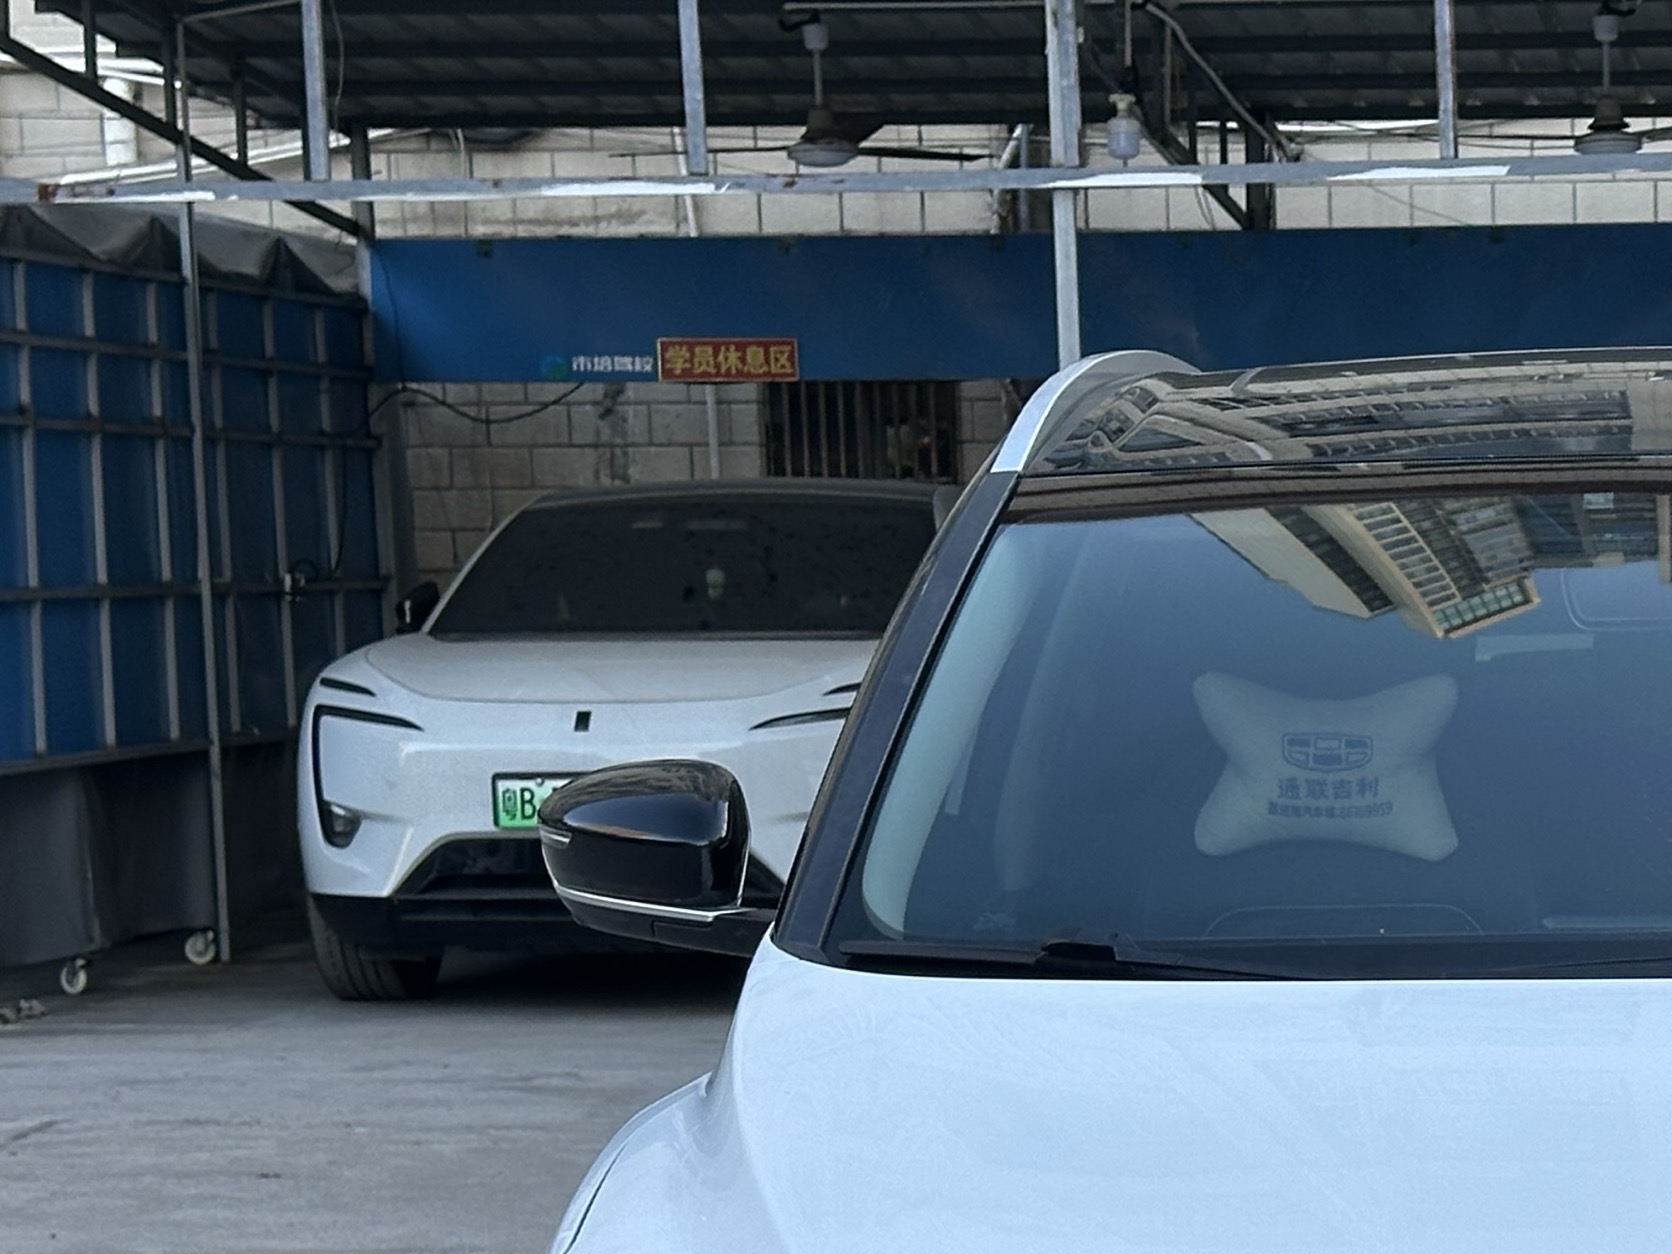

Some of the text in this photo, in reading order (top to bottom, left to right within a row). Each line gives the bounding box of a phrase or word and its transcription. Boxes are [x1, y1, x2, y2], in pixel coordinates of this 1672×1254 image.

[665, 346, 794, 374] 学员休息区
[1277, 776, 1379, 800] 通联吉利
